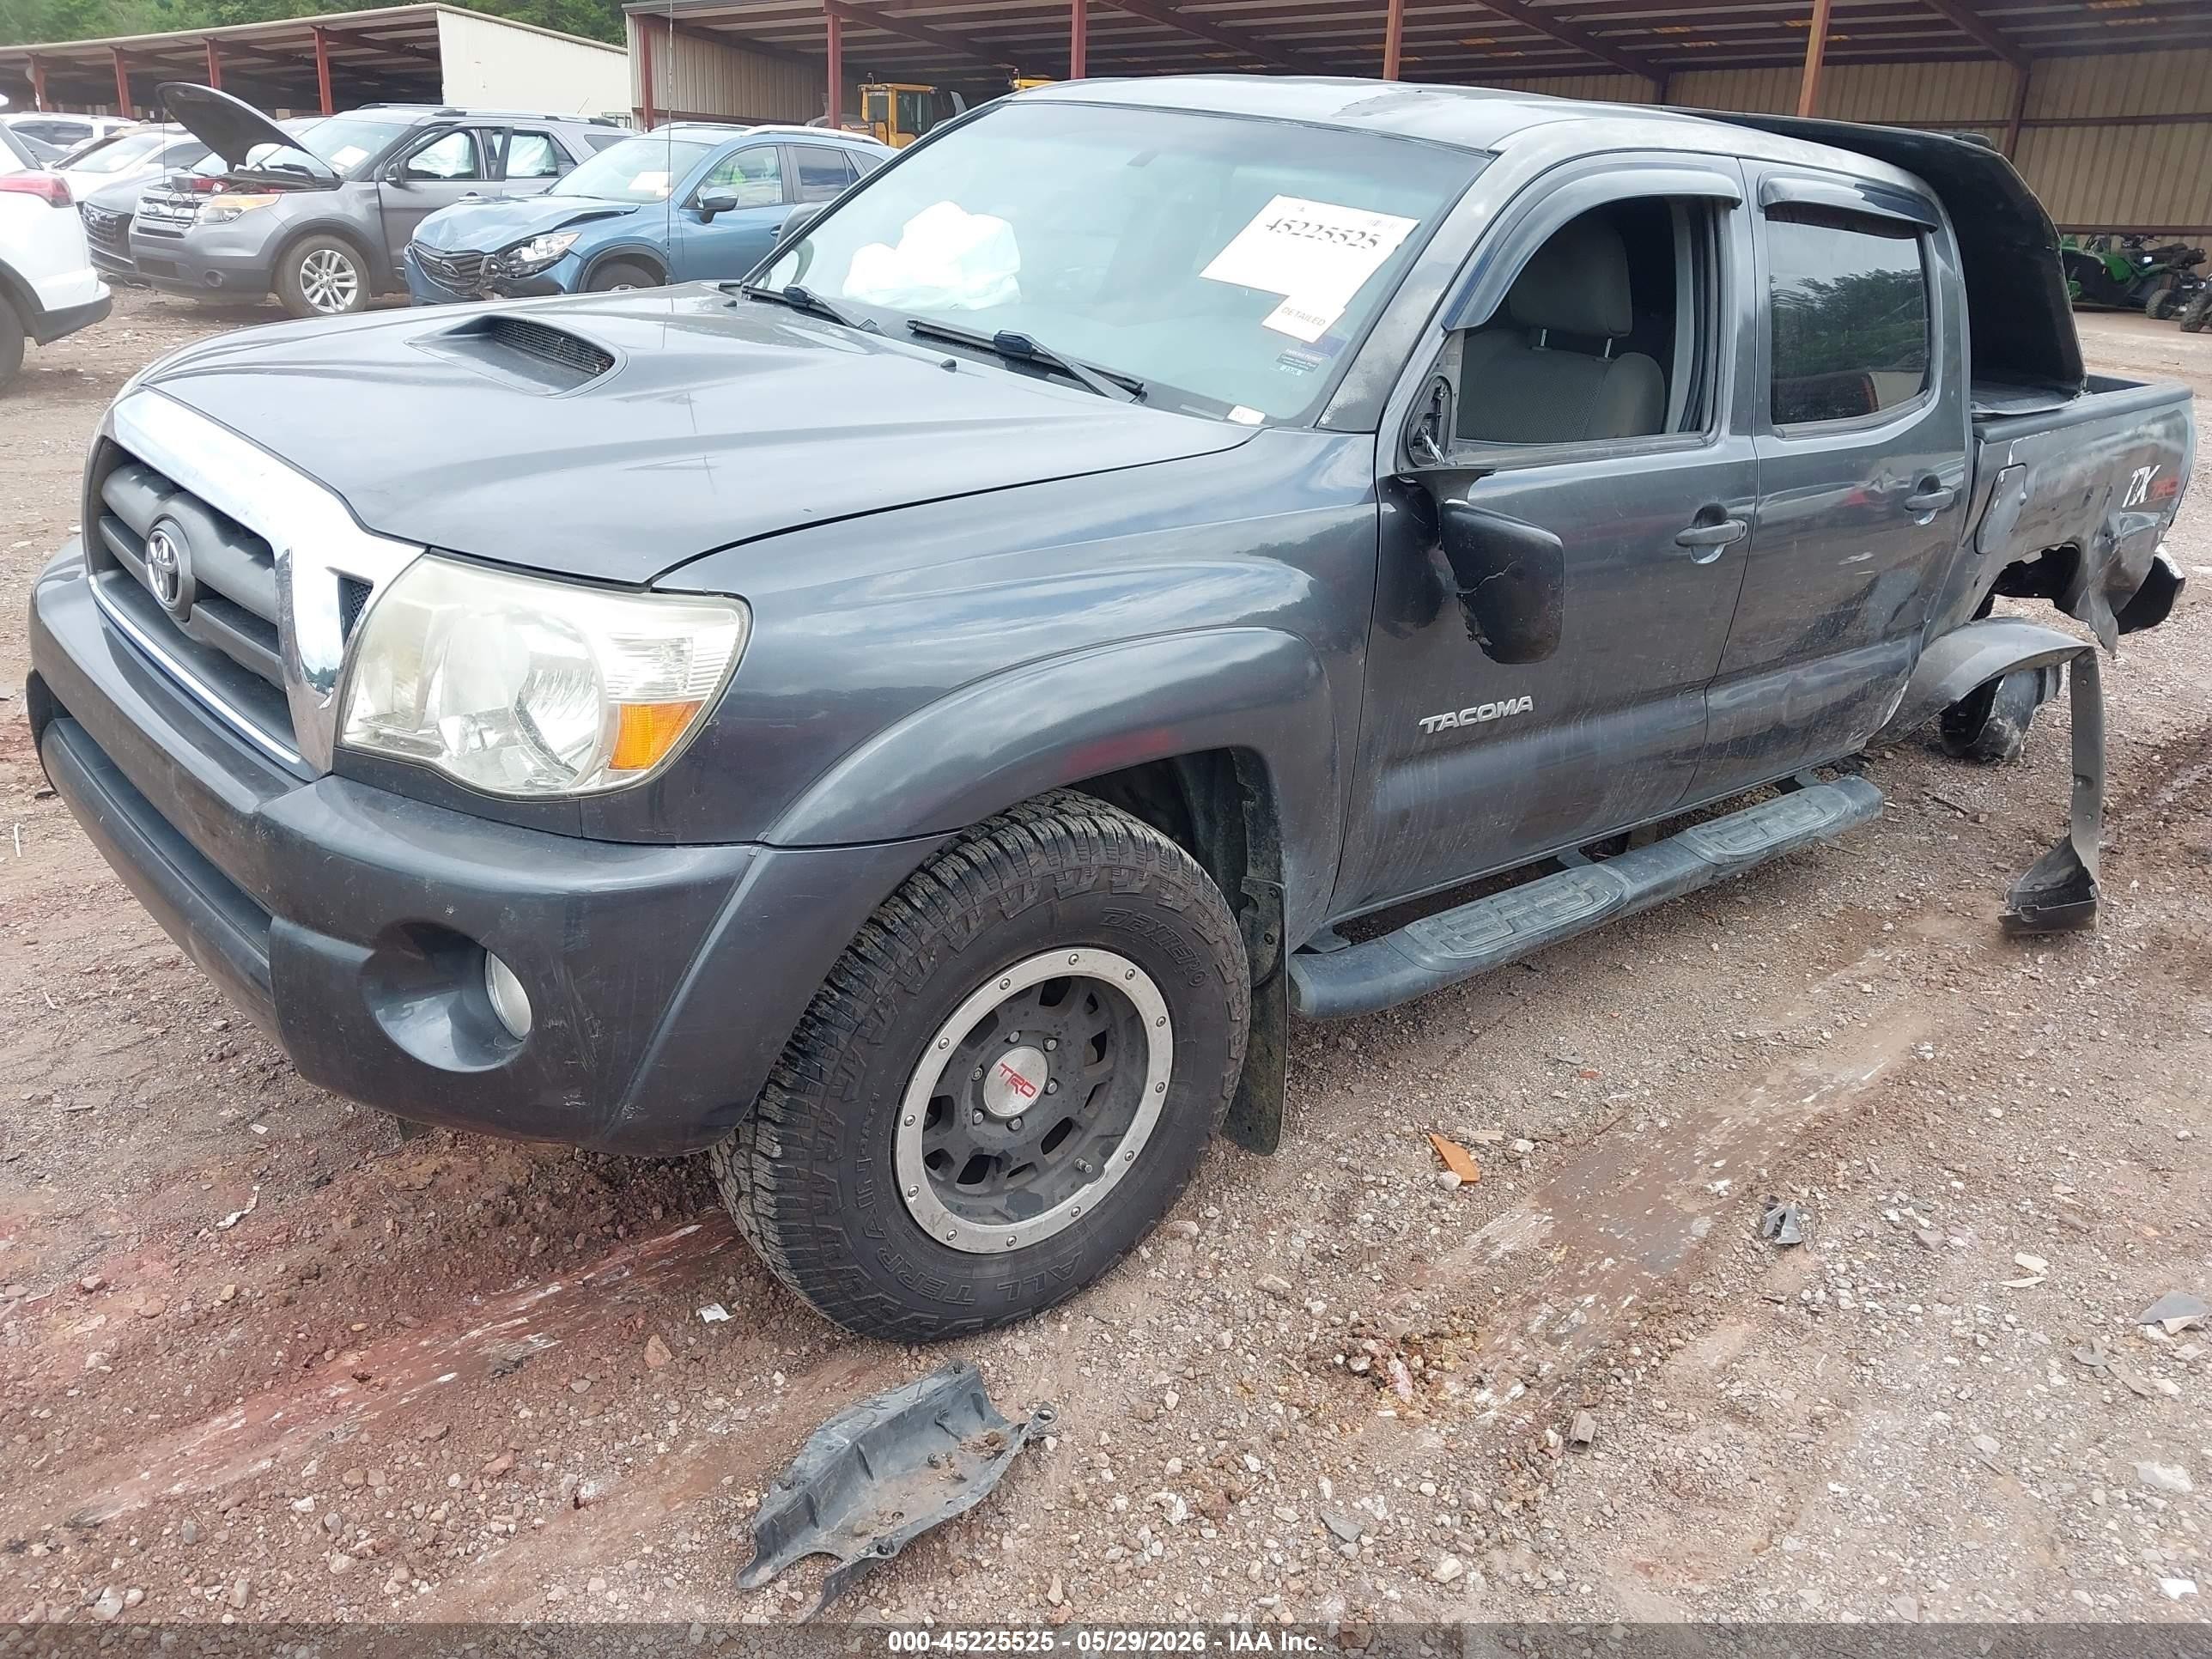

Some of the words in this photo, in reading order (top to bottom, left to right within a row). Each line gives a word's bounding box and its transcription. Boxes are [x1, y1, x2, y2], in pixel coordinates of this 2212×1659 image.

[1265, 217, 1382, 250] 45225525
[1280, 306, 1327, 327] DETAILED
[1418, 696, 1534, 734] TACOMA
[1100, 907, 1207, 988] DEXTERO
[999, 1062, 1037, 1098] TRD
[996, 1250, 1084, 1303] ALL
